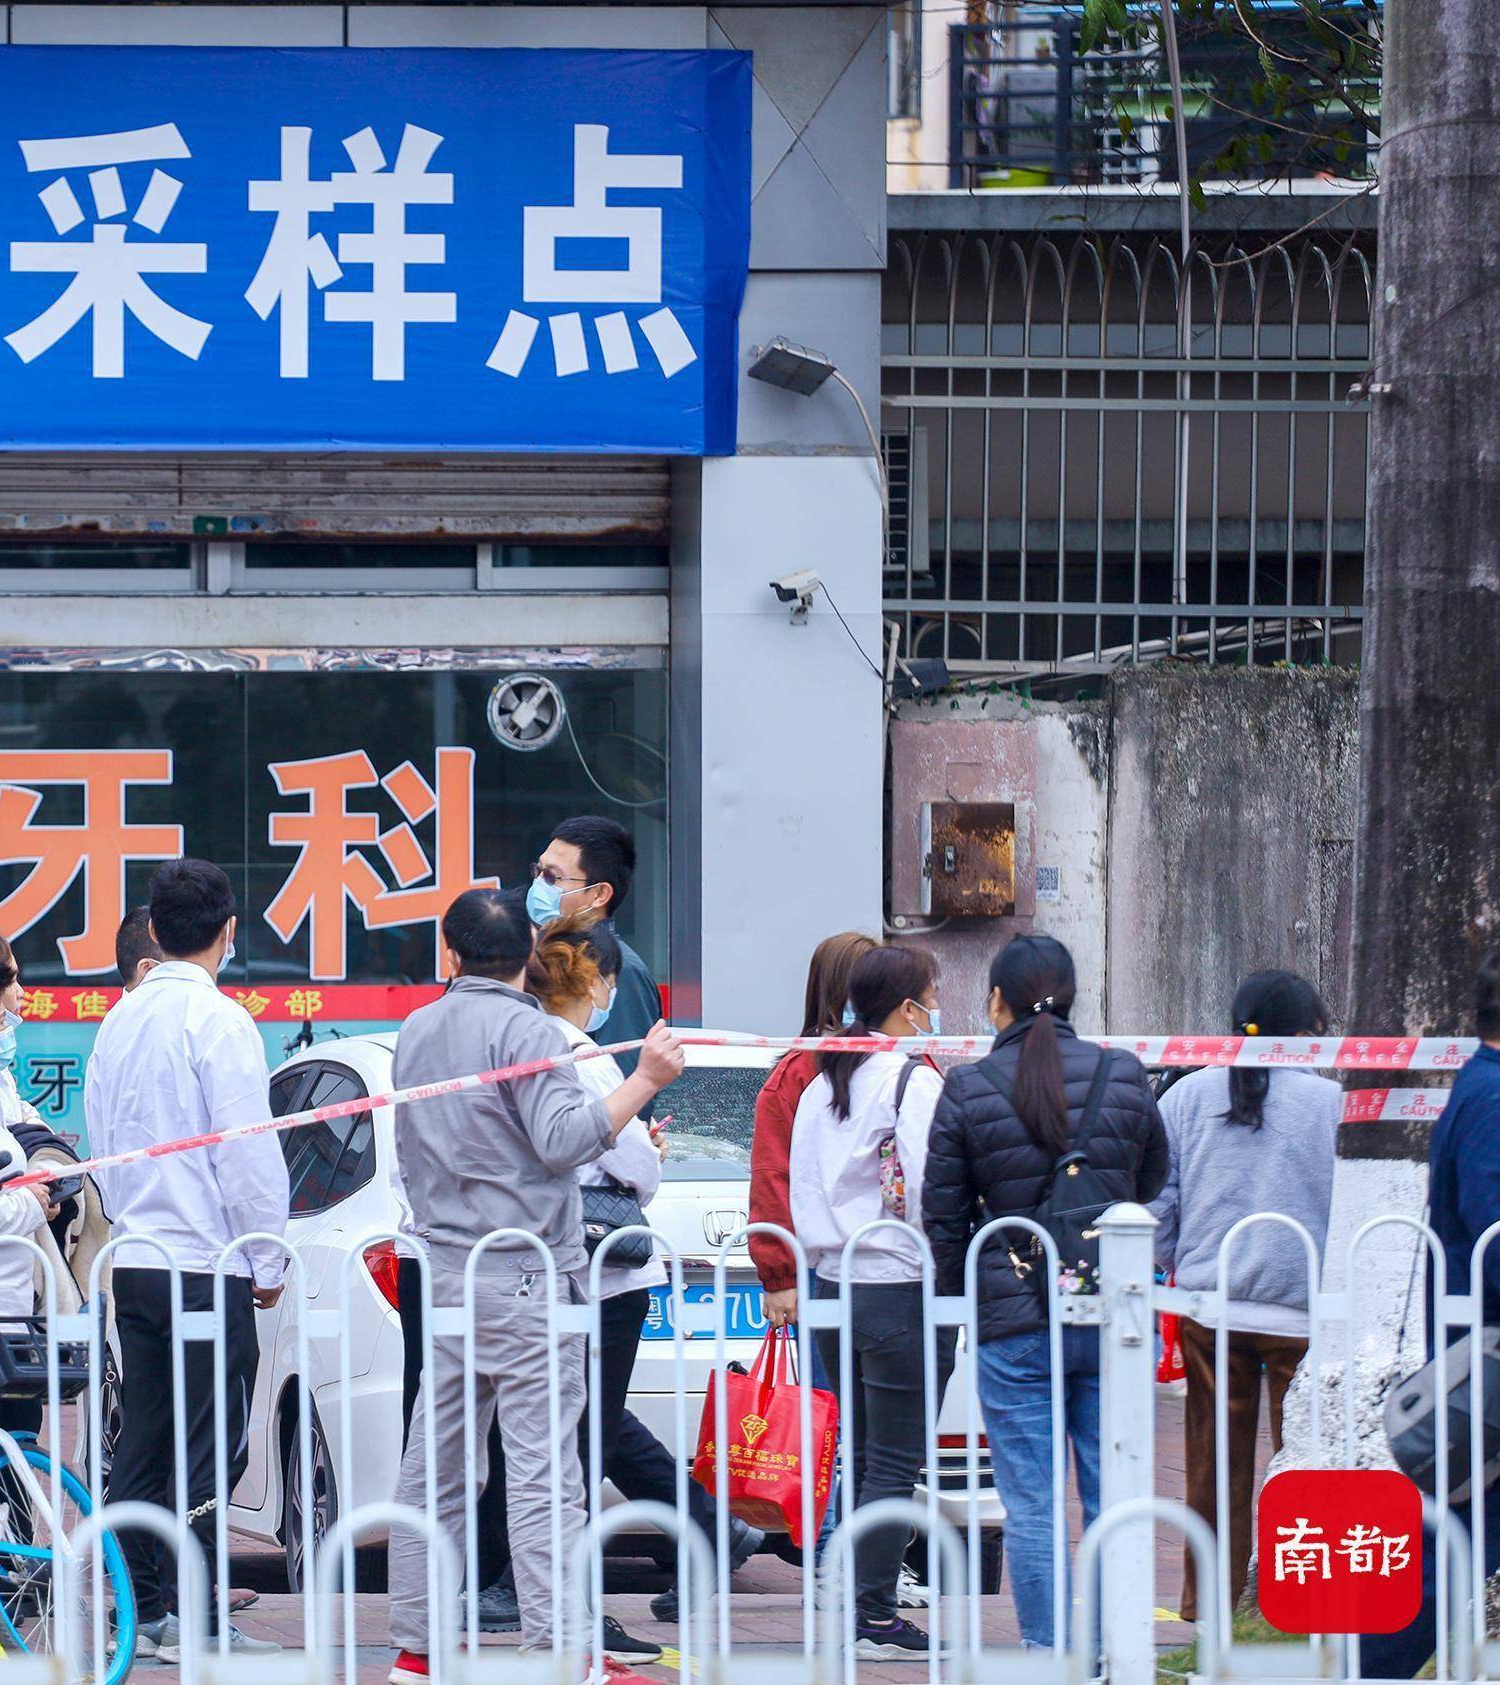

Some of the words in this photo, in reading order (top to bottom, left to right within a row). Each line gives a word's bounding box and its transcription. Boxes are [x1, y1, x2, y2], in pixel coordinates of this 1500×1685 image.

[1168, 1052, 1228, 1062] SAFE
[1257, 1053, 1316, 1064] CAUTION
[1342, 1053, 1402, 1064] SAFE
[704, 1440, 799, 1468] 香尊百福珠寶
